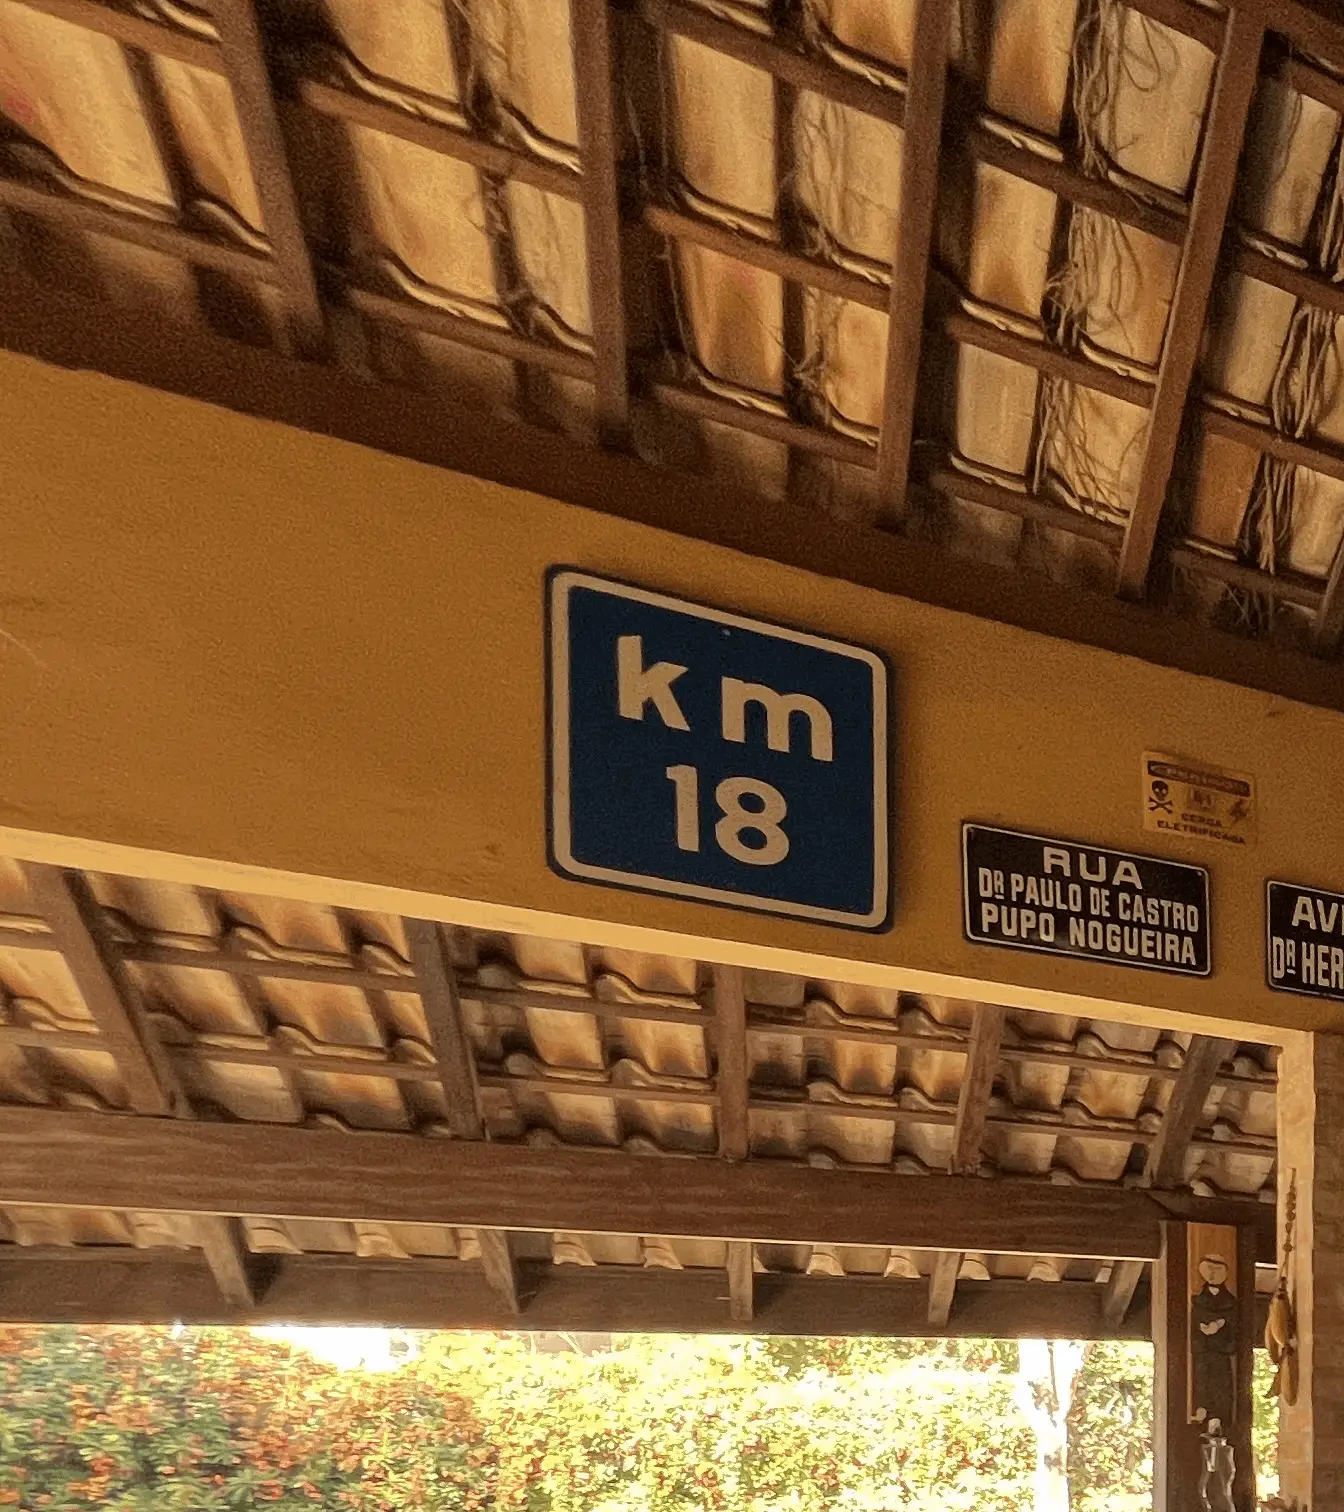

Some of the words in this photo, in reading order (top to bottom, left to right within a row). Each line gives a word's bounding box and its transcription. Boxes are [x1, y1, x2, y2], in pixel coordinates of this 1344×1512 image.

[616, 634, 834, 762] km
[665, 764, 791, 866] 18
[1043, 846, 1143, 890] RUA
[982, 902, 1056, 943] PUPO
[1069, 916, 1197, 966] NOGUEIRA
[1011, 873, 1082, 913] PAULO
[1090, 886, 1111, 918] DE
[1118, 892, 1199, 933] CASTRO
